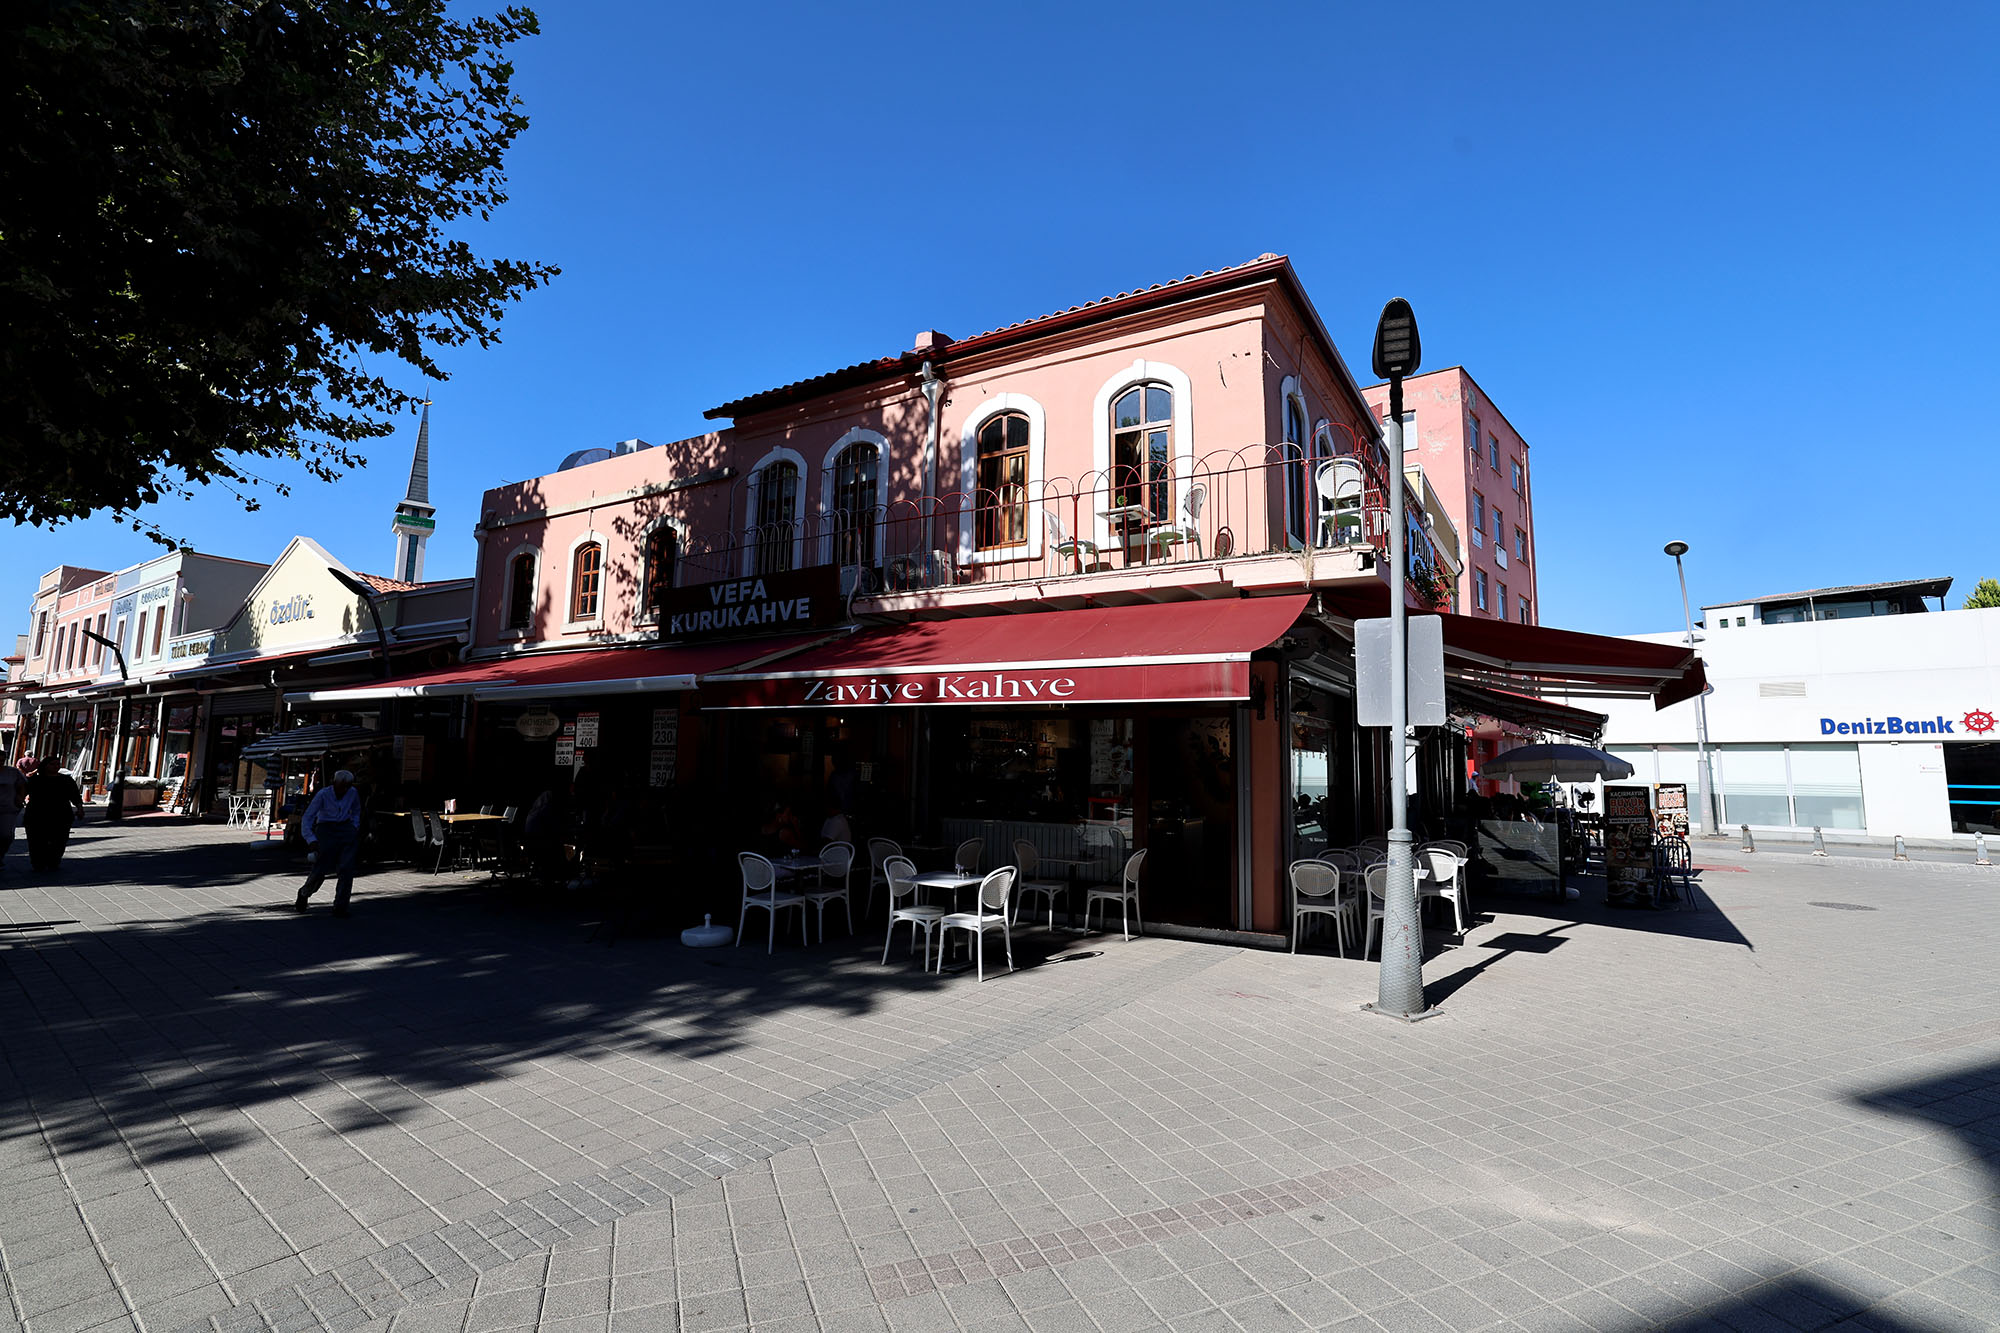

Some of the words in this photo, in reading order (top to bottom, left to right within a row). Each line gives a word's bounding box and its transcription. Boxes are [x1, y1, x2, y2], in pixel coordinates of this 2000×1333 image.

[710, 579, 767, 605] VEFA
[270, 594, 310, 624] özdür
[671, 597, 810, 634] KURUKAHVE
[804, 678, 924, 704] Zaviye
[937, 674, 1076, 699] Kahve
[1820, 716, 1955, 735] DenizBank
[580, 737, 593, 747] 400
[654, 730, 673, 743] 230
[558, 755, 570, 765] 250
[1610, 796, 1645, 806] BÜYÜK
[1610, 806, 1645, 816] FIRSAT
